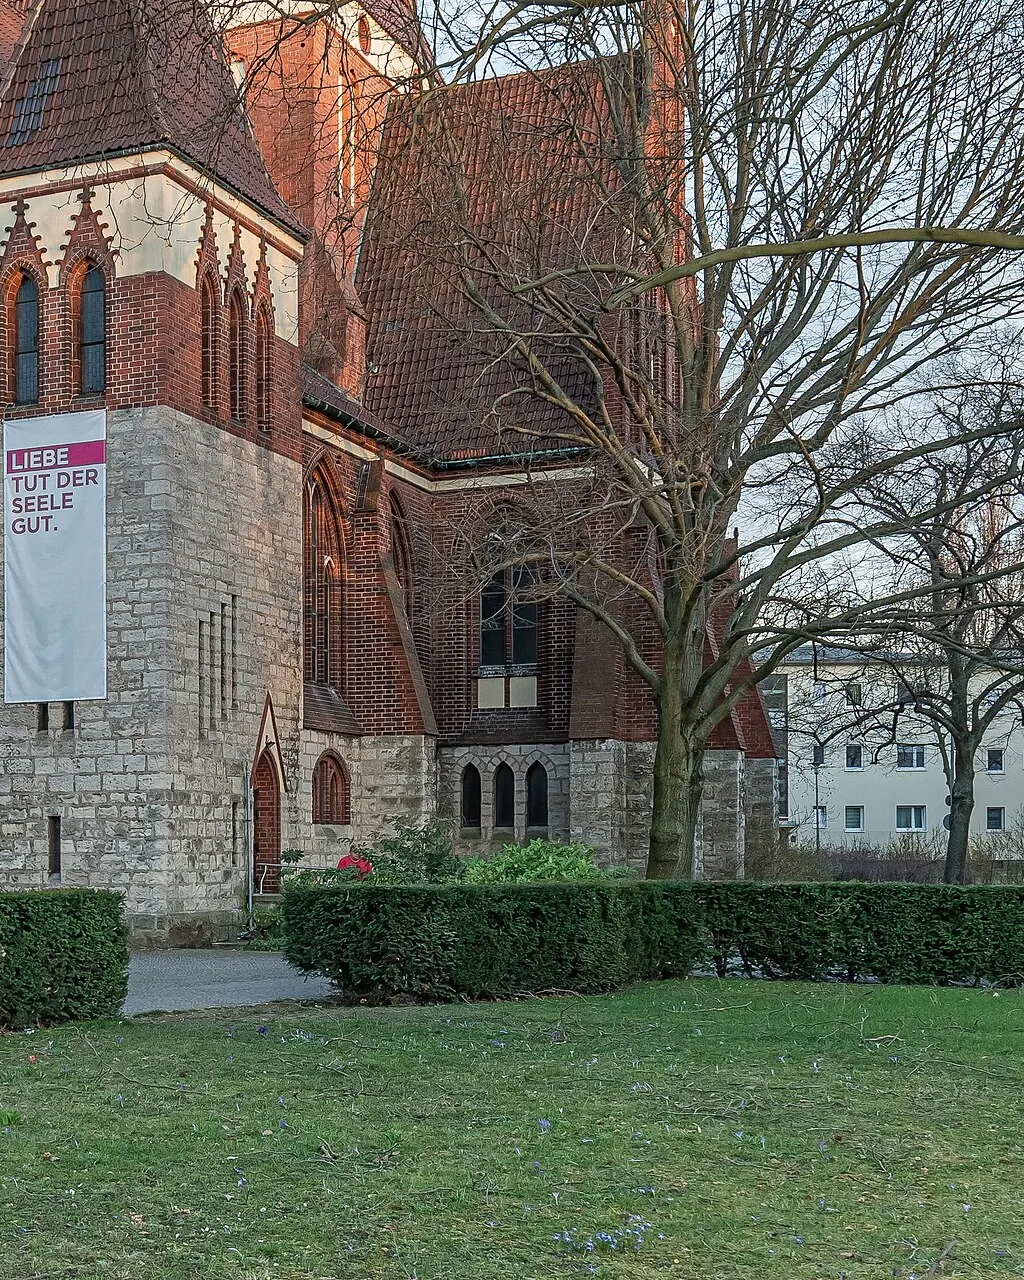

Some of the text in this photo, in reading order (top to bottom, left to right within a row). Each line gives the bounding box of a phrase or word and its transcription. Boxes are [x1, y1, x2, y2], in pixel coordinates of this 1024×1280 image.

[11, 447, 69, 470] LIEBE
[11, 468, 99, 493] TUT DER
[11, 492, 74, 514] SEELE
[11, 515, 58, 535] GUT.
